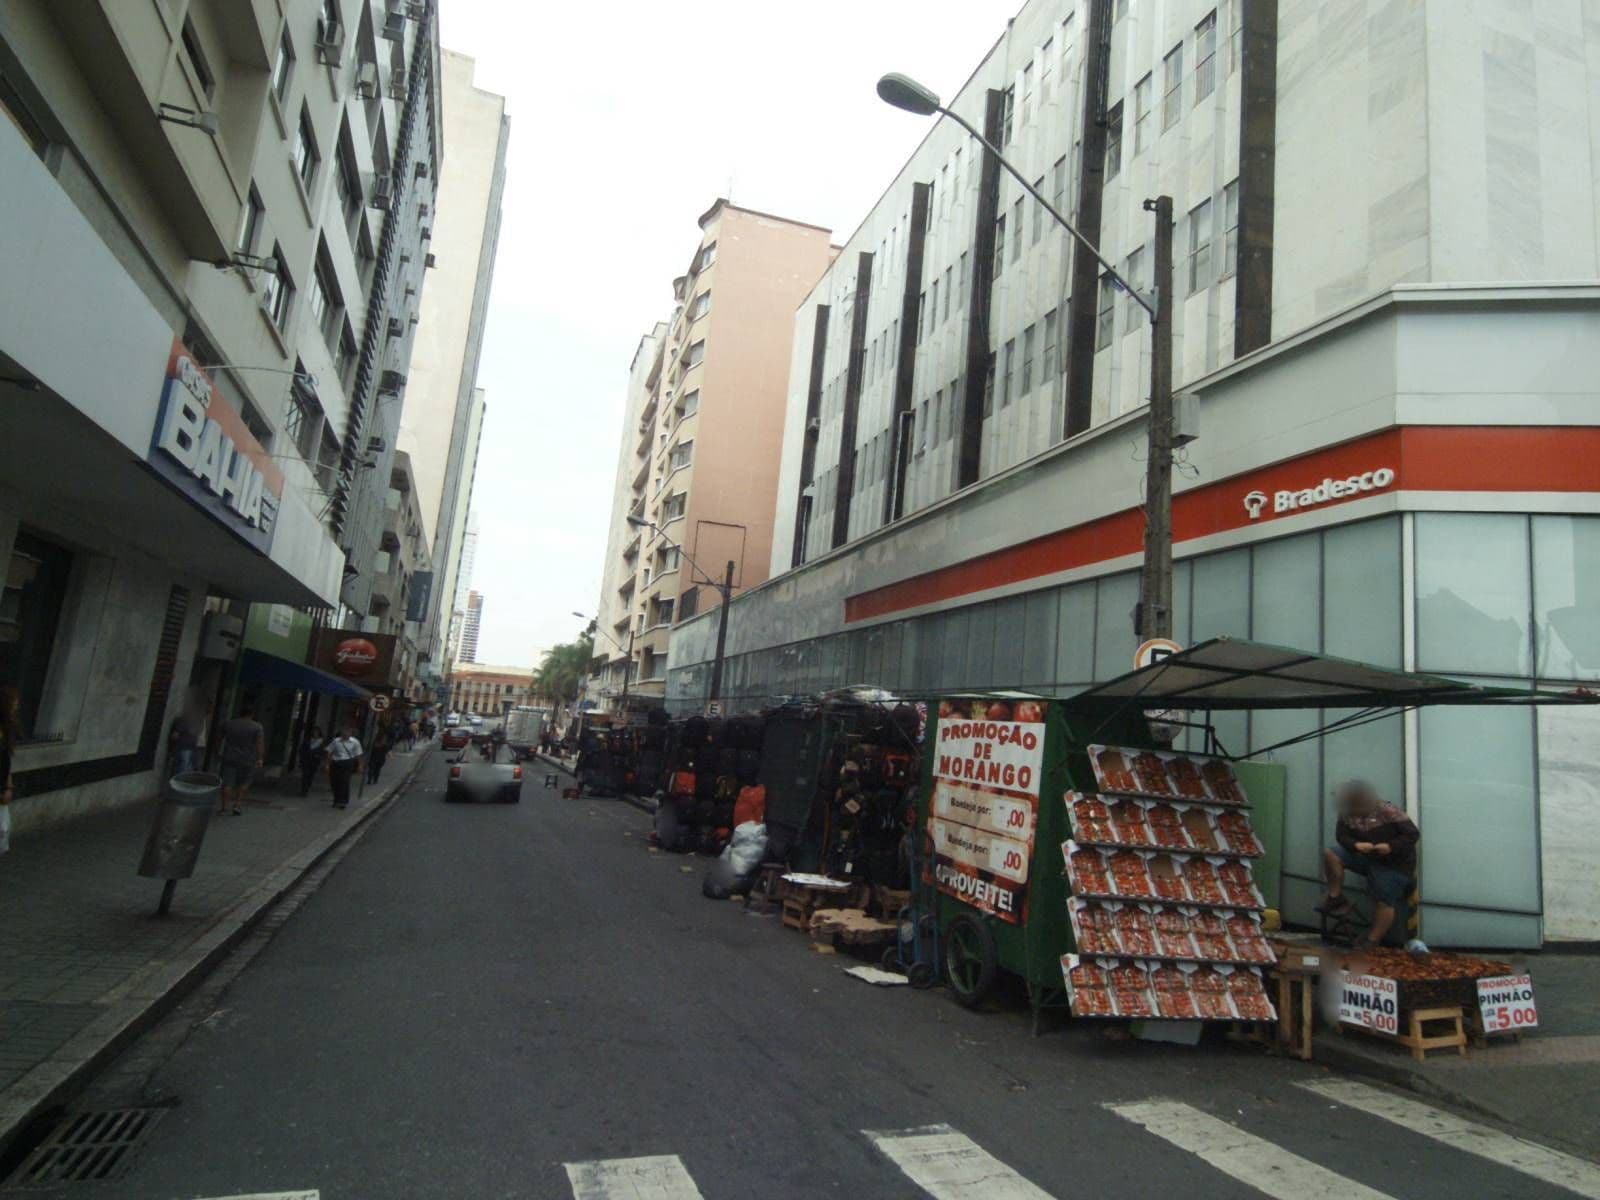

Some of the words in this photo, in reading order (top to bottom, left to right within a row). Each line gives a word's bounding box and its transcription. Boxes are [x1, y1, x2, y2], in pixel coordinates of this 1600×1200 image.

[158, 378, 265, 529] BAHIA
[1274, 467, 1395, 513] Bradesco
[942, 723, 1037, 750] PROMOÇÃO
[974, 744, 992, 760] DE
[940, 756, 1032, 789] MORANGO
[1342, 989, 1395, 1015] INHÃO
[1479, 988, 1533, 1006] PINHÃO
